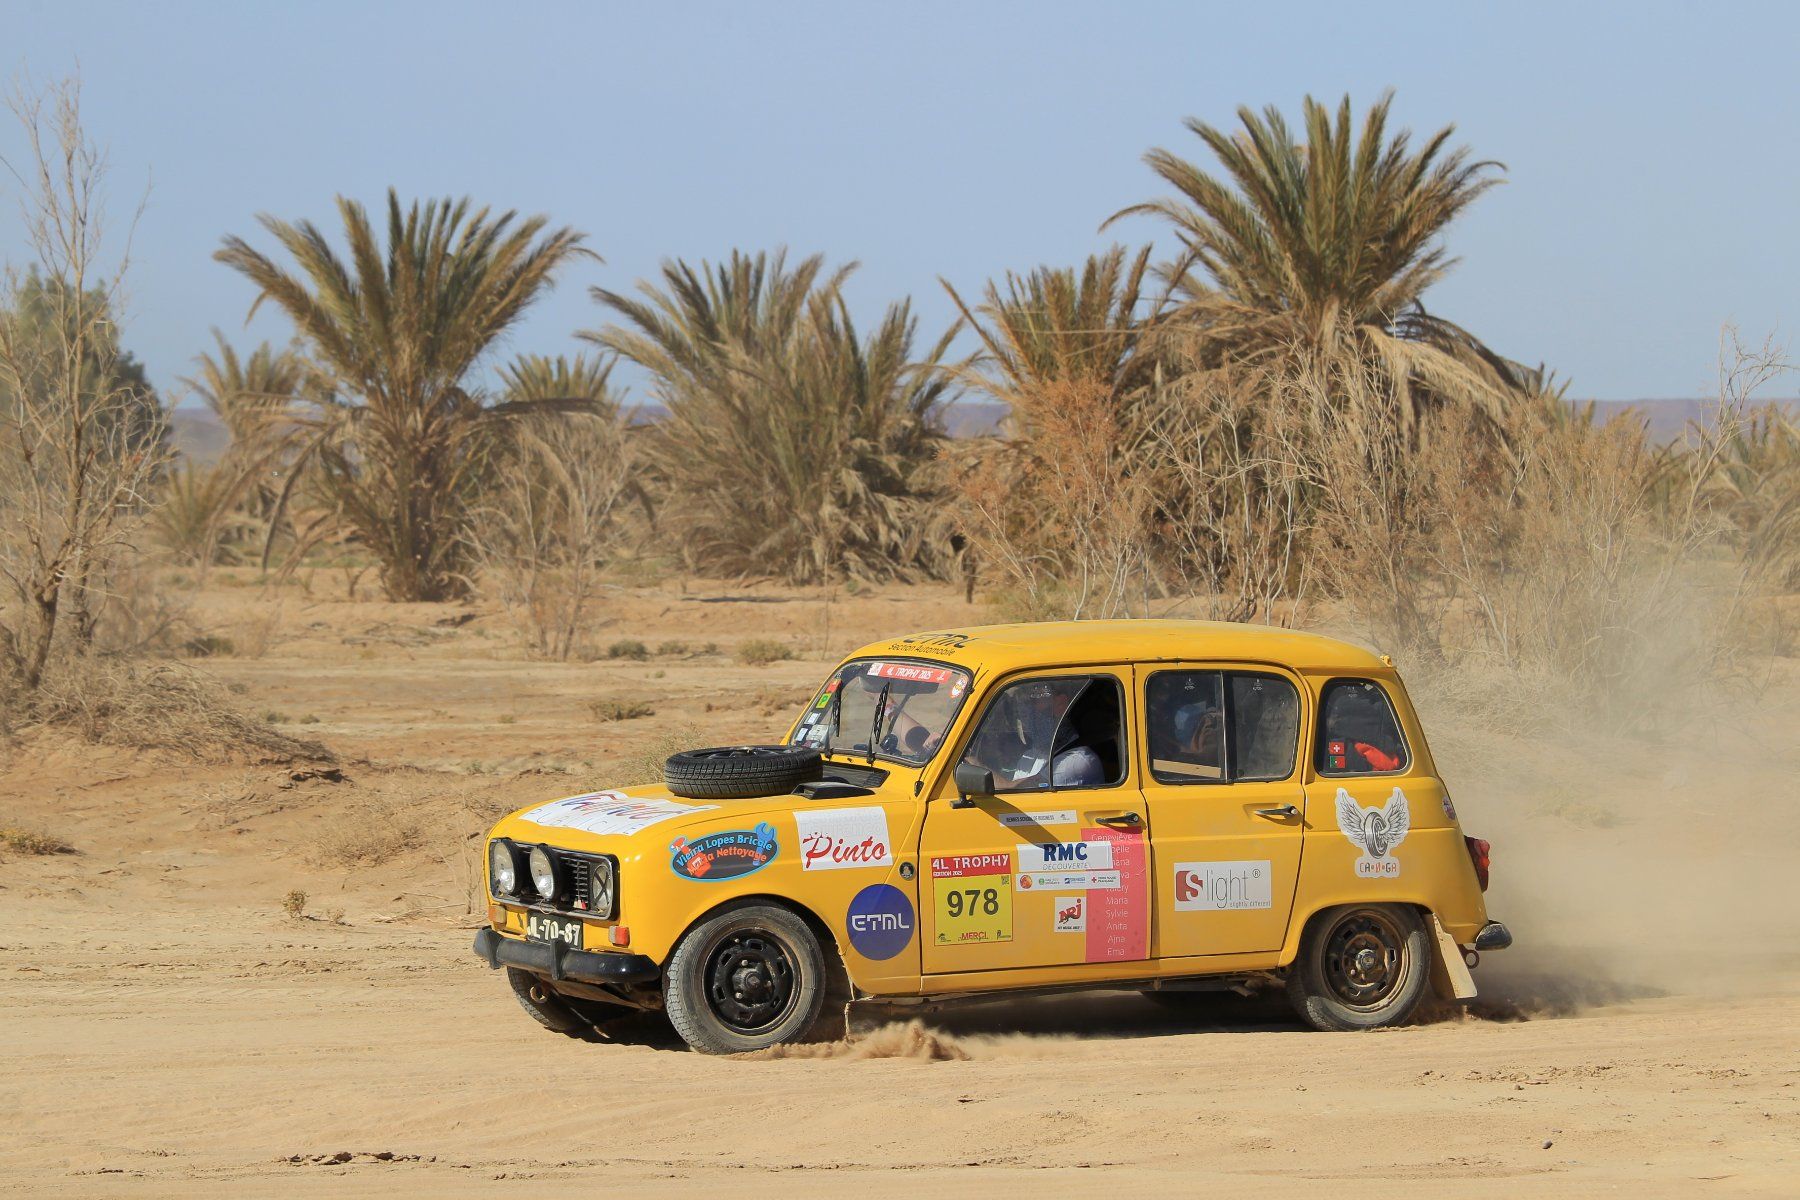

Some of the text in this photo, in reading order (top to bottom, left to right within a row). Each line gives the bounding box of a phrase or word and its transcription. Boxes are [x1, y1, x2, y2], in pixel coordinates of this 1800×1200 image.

[896, 667, 919, 678] TROPHY
[706, 836, 735, 849] Lopes
[717, 846, 767, 862] Nettoyage
[802, 835, 887, 868] Pinto
[1043, 843, 1088, 861] RMC
[932, 854, 1009, 870] 4L TROPHY
[947, 888, 999, 917] 978
[1106, 896, 1128, 905] Maria
[1106, 909, 1128, 919] Sylvie
[851, 912, 910, 931] ETML
[1106, 922, 1128, 930] Anita
[961, 931, 987, 939] MERCI
[1107, 948, 1125, 956] Ema
